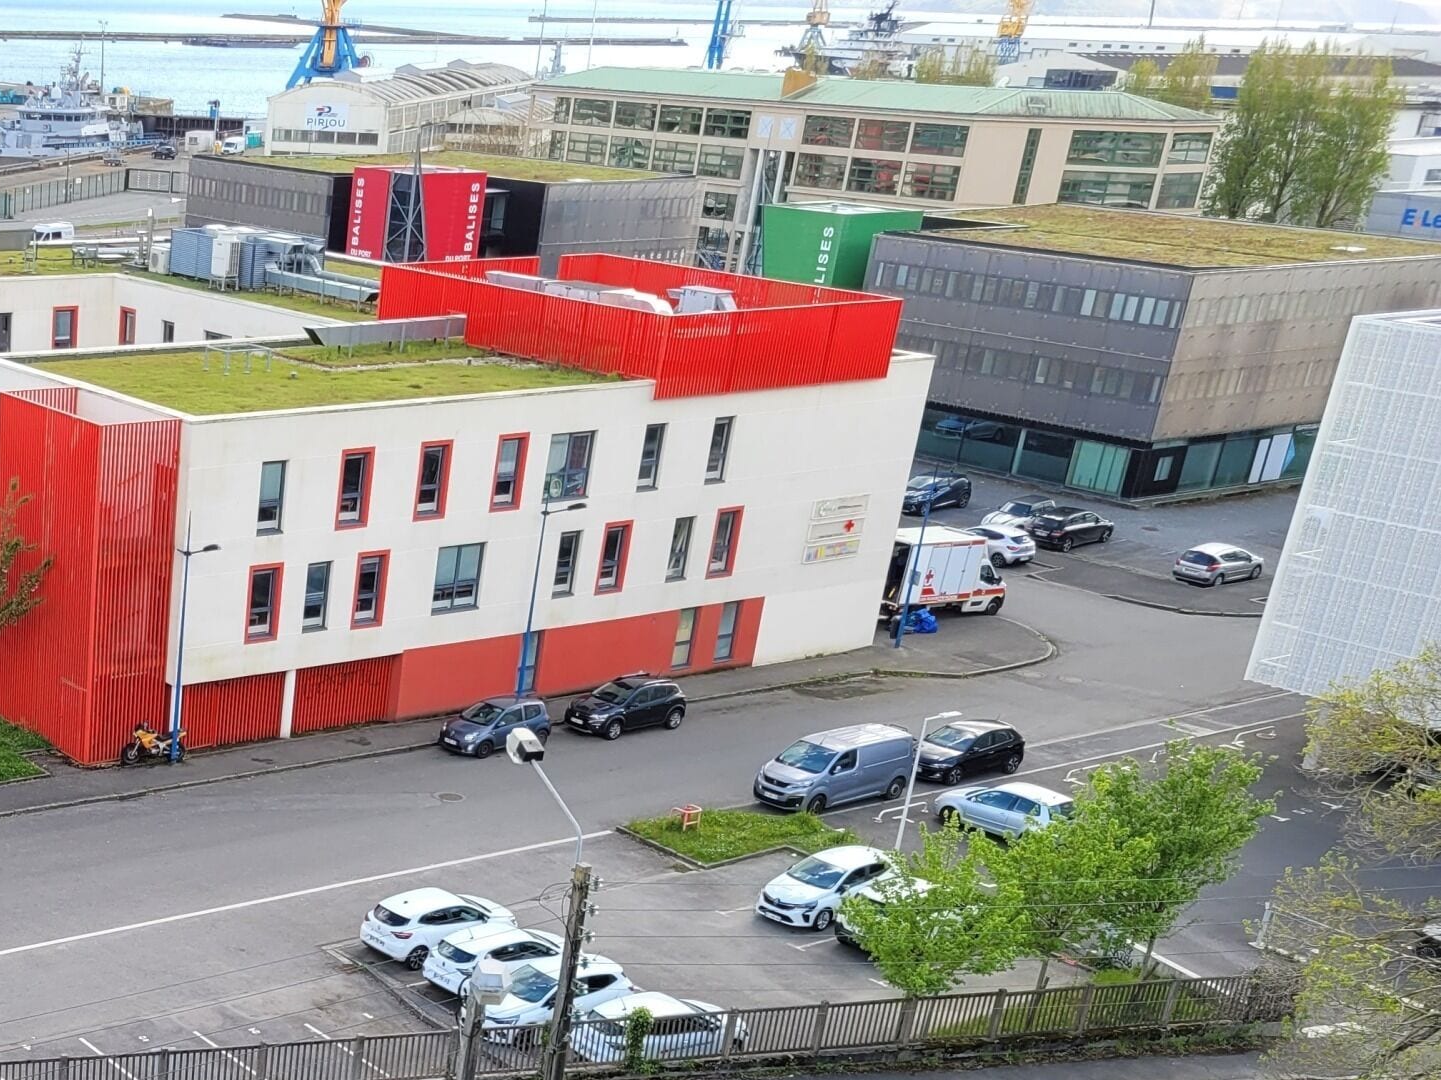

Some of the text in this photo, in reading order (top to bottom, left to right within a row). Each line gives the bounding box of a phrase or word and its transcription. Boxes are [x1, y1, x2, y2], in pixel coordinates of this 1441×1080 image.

[306, 117, 346, 130] PIRIOU
[350, 177, 365, 246] BALISES
[463, 182, 480, 252] BALISES
[814, 226, 835, 284] LISES
